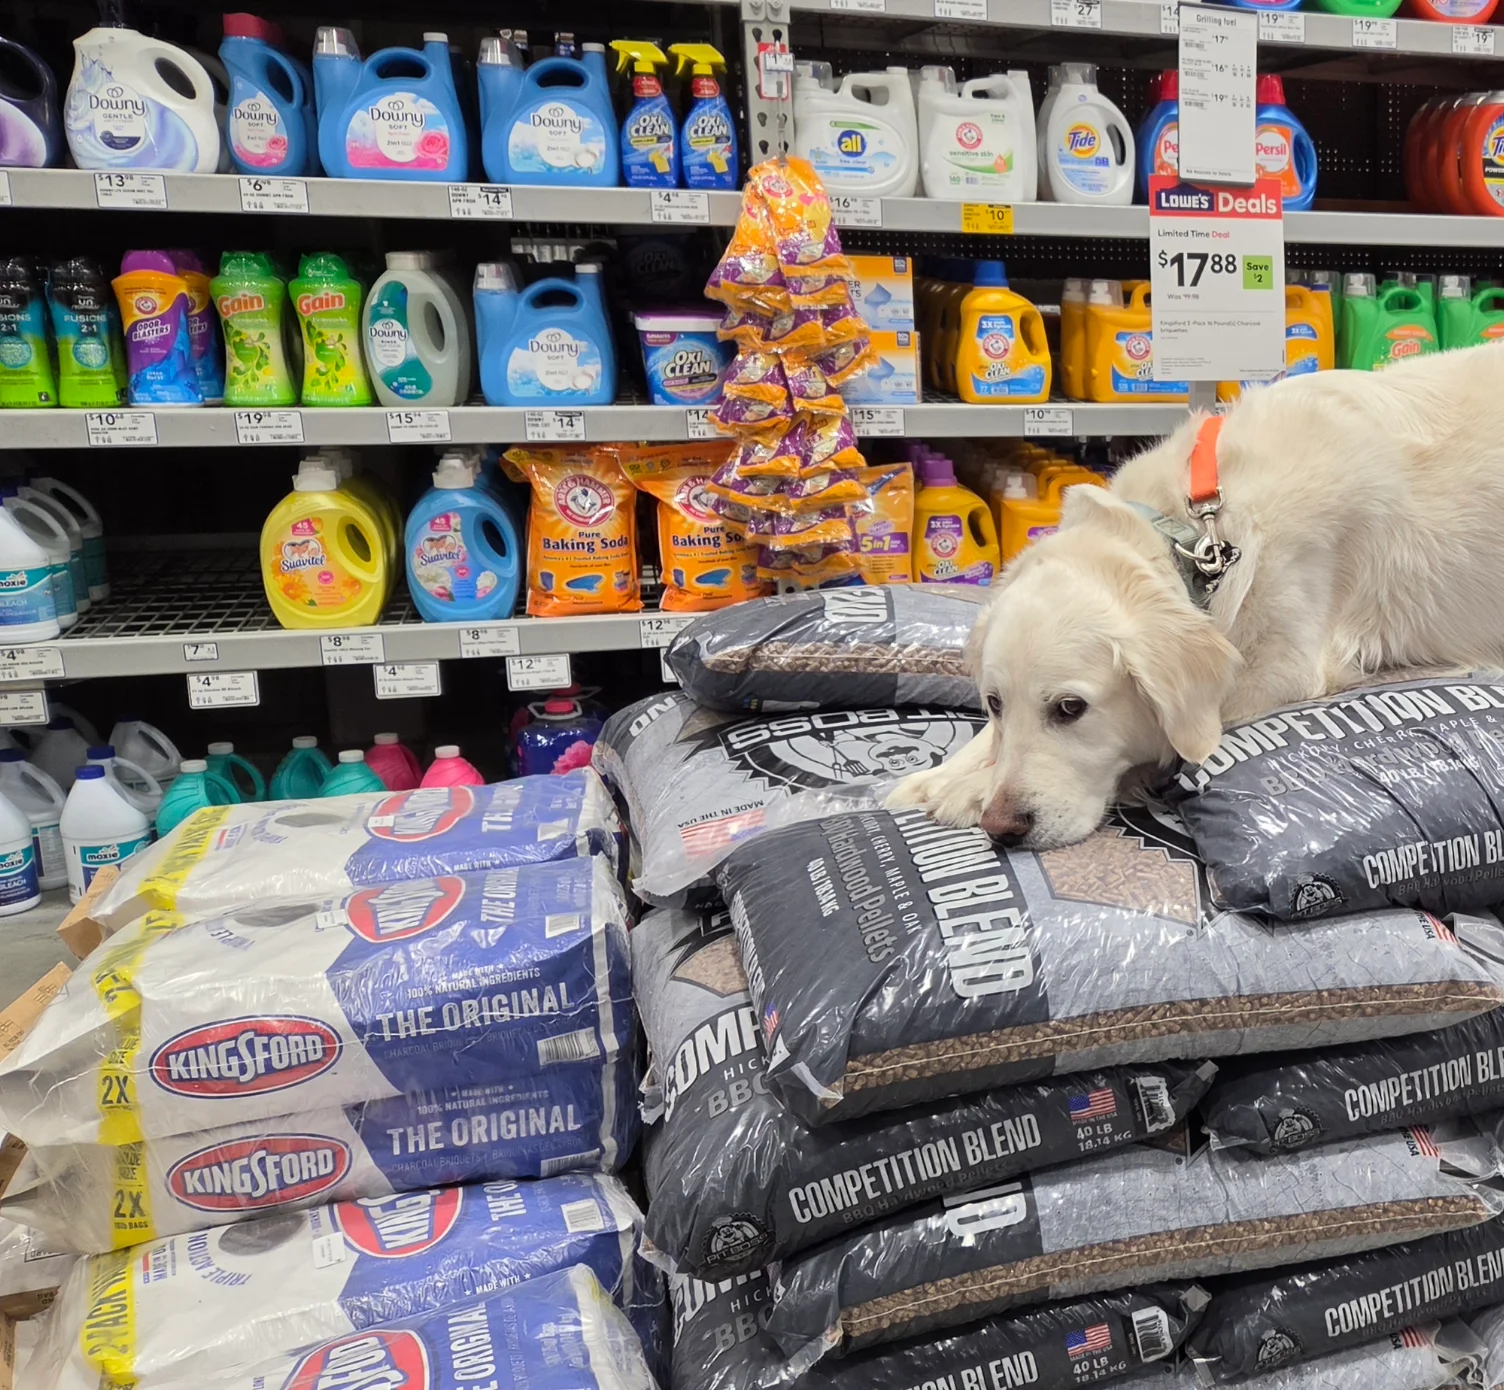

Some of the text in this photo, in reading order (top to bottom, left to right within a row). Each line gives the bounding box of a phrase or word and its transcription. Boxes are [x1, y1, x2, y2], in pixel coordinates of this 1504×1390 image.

[1196, 14, 1237, 27] Grilling fuel
[234, 110, 277, 126] Downy
[371, 108, 424, 127] Downy
[532, 114, 582, 133] Downy
[639, 115, 663, 126] OXI
[697, 115, 721, 126] OXI
[631, 124, 669, 136] CLEAN
[690, 125, 729, 136] CLEAN
[840, 134, 865, 153] all
[1068, 131, 1096, 149] Tide
[1256, 142, 1287, 155] Persil
[1161, 192, 1277, 214] LOWE'S Deals
[1158, 229, 1189, 238] Limited
[1191, 230, 1210, 238] Time
[1247, 262, 1269, 272] Save
[1254, 274, 1263, 283] $2
[219, 293, 263, 317] Gain
[298, 293, 344, 316] Gain
[132, 325, 170, 341] BLASTERS
[136, 319, 161, 332] ODOR
[982, 321, 993, 329] 3X
[530, 340, 579, 357] Downy
[675, 351, 702, 367] OXI
[664, 359, 712, 378] CLEAN
[542, 535, 629, 553] Baking Soda
[281, 555, 325, 572] Suavitel
[420, 550, 462, 566] Suavitel
[87, 851, 119, 861] moxie
[407, 967, 540, 999] 100% NATURAL INGREDIENTS
[376, 982, 575, 1042] THE ORIGINAL
[168, 1031, 324, 1082] KINGSFORD
[418, 1090, 549, 1115] 100% NATURAL INGREDIENTS
[387, 1104, 581, 1156] THE ORIGINAL
[1076, 1123, 1113, 1139] 40 LB
[1079, 1131, 1131, 1151] 18.14 KG
[182, 1149, 334, 1198] KINGSFORD
[128, 1221, 148, 1230] BAGS
[476, 1274, 520, 1295] MADE WITH
[1325, 1266, 1454, 1337] COMPETITION
